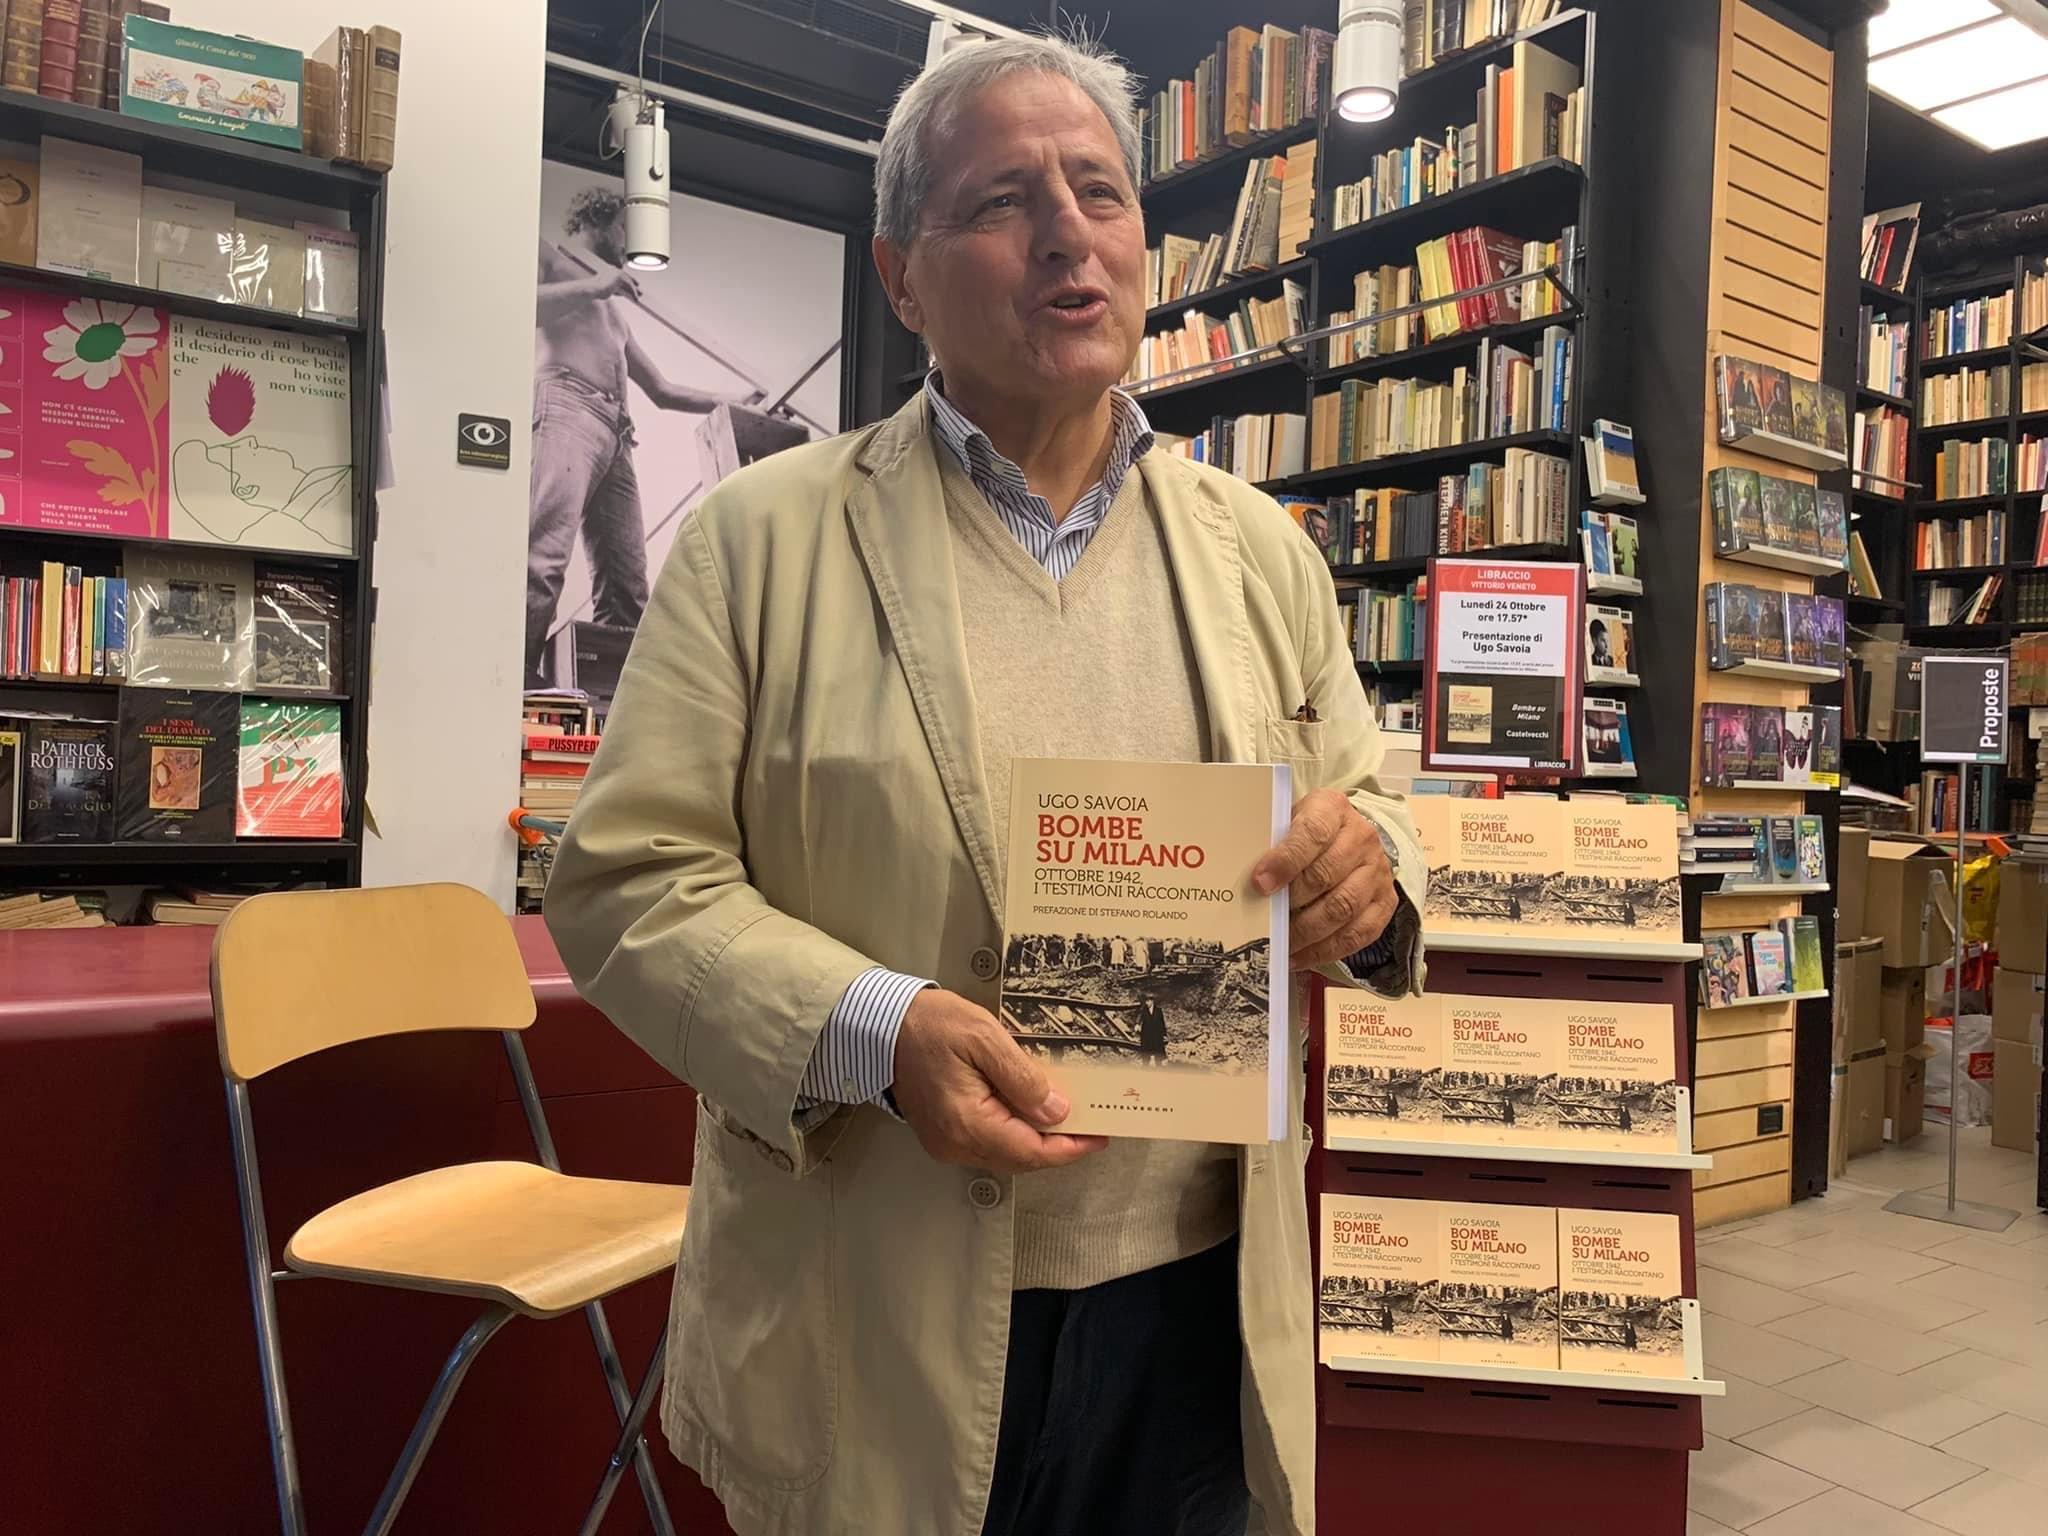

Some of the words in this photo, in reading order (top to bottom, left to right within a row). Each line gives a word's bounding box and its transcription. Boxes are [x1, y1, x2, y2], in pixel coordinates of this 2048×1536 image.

[174, 322, 184, 334] il
[195, 325, 262, 346] desiderio
[273, 338, 290, 350] mi
[302, 340, 345, 358] brucia
[174, 336, 184, 348] il
[189, 338, 256, 359] desiderio
[260, 348, 274, 362] di
[280, 355, 309, 367] cose
[314, 357, 346, 373] belle
[173, 351, 199, 365] che
[294, 367, 311, 381] ho
[315, 373, 346, 387] viste
[173, 368, 182, 377] e
[269, 381, 296, 393] non
[299, 385, 347, 401] vissute
[1440, 475, 1451, 519] STEPHEN
[1440, 521, 1449, 555] KING
[1477, 569, 1531, 580] LIBRACCIO
[1471, 581, 1505, 589] VITTORIO
[1507, 582, 1537, 590] VENETO
[1460, 599, 1494, 609] Lunedì
[1496, 601, 1507, 609] 24
[1510, 602, 1546, 611] Ottobre
[1478, 614, 1494, 622] ore
[1462, 630, 1532, 642] Presentazione
[1533, 633, 1543, 642] di
[1473, 642, 1494, 654] Ugo
[1496, 643, 1531, 653] Savoia
[1511, 703, 1536, 711] Bombe
[1979, 668, 2003, 748] Proposte
[1517, 712, 1541, 720] Milano
[145, 725, 166, 734] DEL
[167, 726, 211, 736] DIAVOLO
[1505, 729, 1549, 739] Castelvecchi
[40, 740, 106, 757] PATRICK
[31, 752, 114, 771] ROTHFUSS
[1534, 760, 1566, 769] LIBRACCIO
[1038, 794, 1079, 809] UGO
[1084, 796, 1149, 811] SAVOIA
[1037, 814, 1143, 840] BOMBE
[1461, 821, 1507, 832] BOMBE
[1593, 818, 1622, 826] SAVOIA
[1461, 832, 1478, 842] SU
[1481, 832, 1534, 844] MILANO
[1574, 826, 1620, 838] BOMBE
[1574, 837, 1591, 847] SU
[1594, 838, 1648, 849] MILANO
[1036, 840, 1075, 863] SU
[1083, 841, 1205, 868] MILANO
[1501, 850, 1548, 858] RACCONTANO
[1034, 868, 1105, 882] OTTOBRE
[1108, 871, 1143, 885] 1942,
[1041, 882, 1123, 898] TESTIMONI
[1127, 886, 1234, 902] RACCONTANO
[1033, 905, 1088, 917] PREFAZIONE
[1089, 907, 1099, 917] DI
[1100, 908, 1141, 919] STEFANO
[1142, 910, 1188, 920] ROLANDO
[1359, 1005, 1387, 1013] SAVOIA
[1339, 1013, 1385, 1025] BOMBE
[1453, 1019, 1500, 1031] BOMBE
[1339, 1024, 1356, 1034] SU
[1360, 1025, 1412, 1037] MILANO
[1453, 1030, 1470, 1041] SU
[1474, 1031, 1527, 1043] MILANO
[1568, 1025, 1616, 1037] BOMBE
[1379, 1044, 1426, 1052] RACCONTANO
[1568, 1036, 1586, 1047] SU
[1590, 1037, 1644, 1049] MILANO
[1610, 1056, 1658, 1064] RACCONTANO
[1333, 1211, 1352, 1219] UGO
[1353, 1212, 1383, 1220] SAVOIA
[1333, 1220, 1381, 1234] BOMBE
[1450, 1218, 1469, 1226] UGO
[1471, 1219, 1500, 1227] SAVOIA
[1451, 1228, 1498, 1240] BOMBE
[1571, 1225, 1590, 1233] UGO
[1592, 1226, 1622, 1235] SAVOIA
[1333, 1233, 1350, 1244] SU
[1354, 1234, 1408, 1247] MILANO
[1572, 1235, 1620, 1248] BOMBE
[1451, 1240, 1468, 1251] SU
[1472, 1241, 1527, 1254] MILANO
[1374, 1254, 1422, 1263] RACCONTANO
[1572, 1247, 1589, 1259] SU
[1594, 1248, 1649, 1262] MILANO
[1493, 1261, 1541, 1270] RACCONTANO
[1614, 1269, 1664, 1279] RACCONTANO
